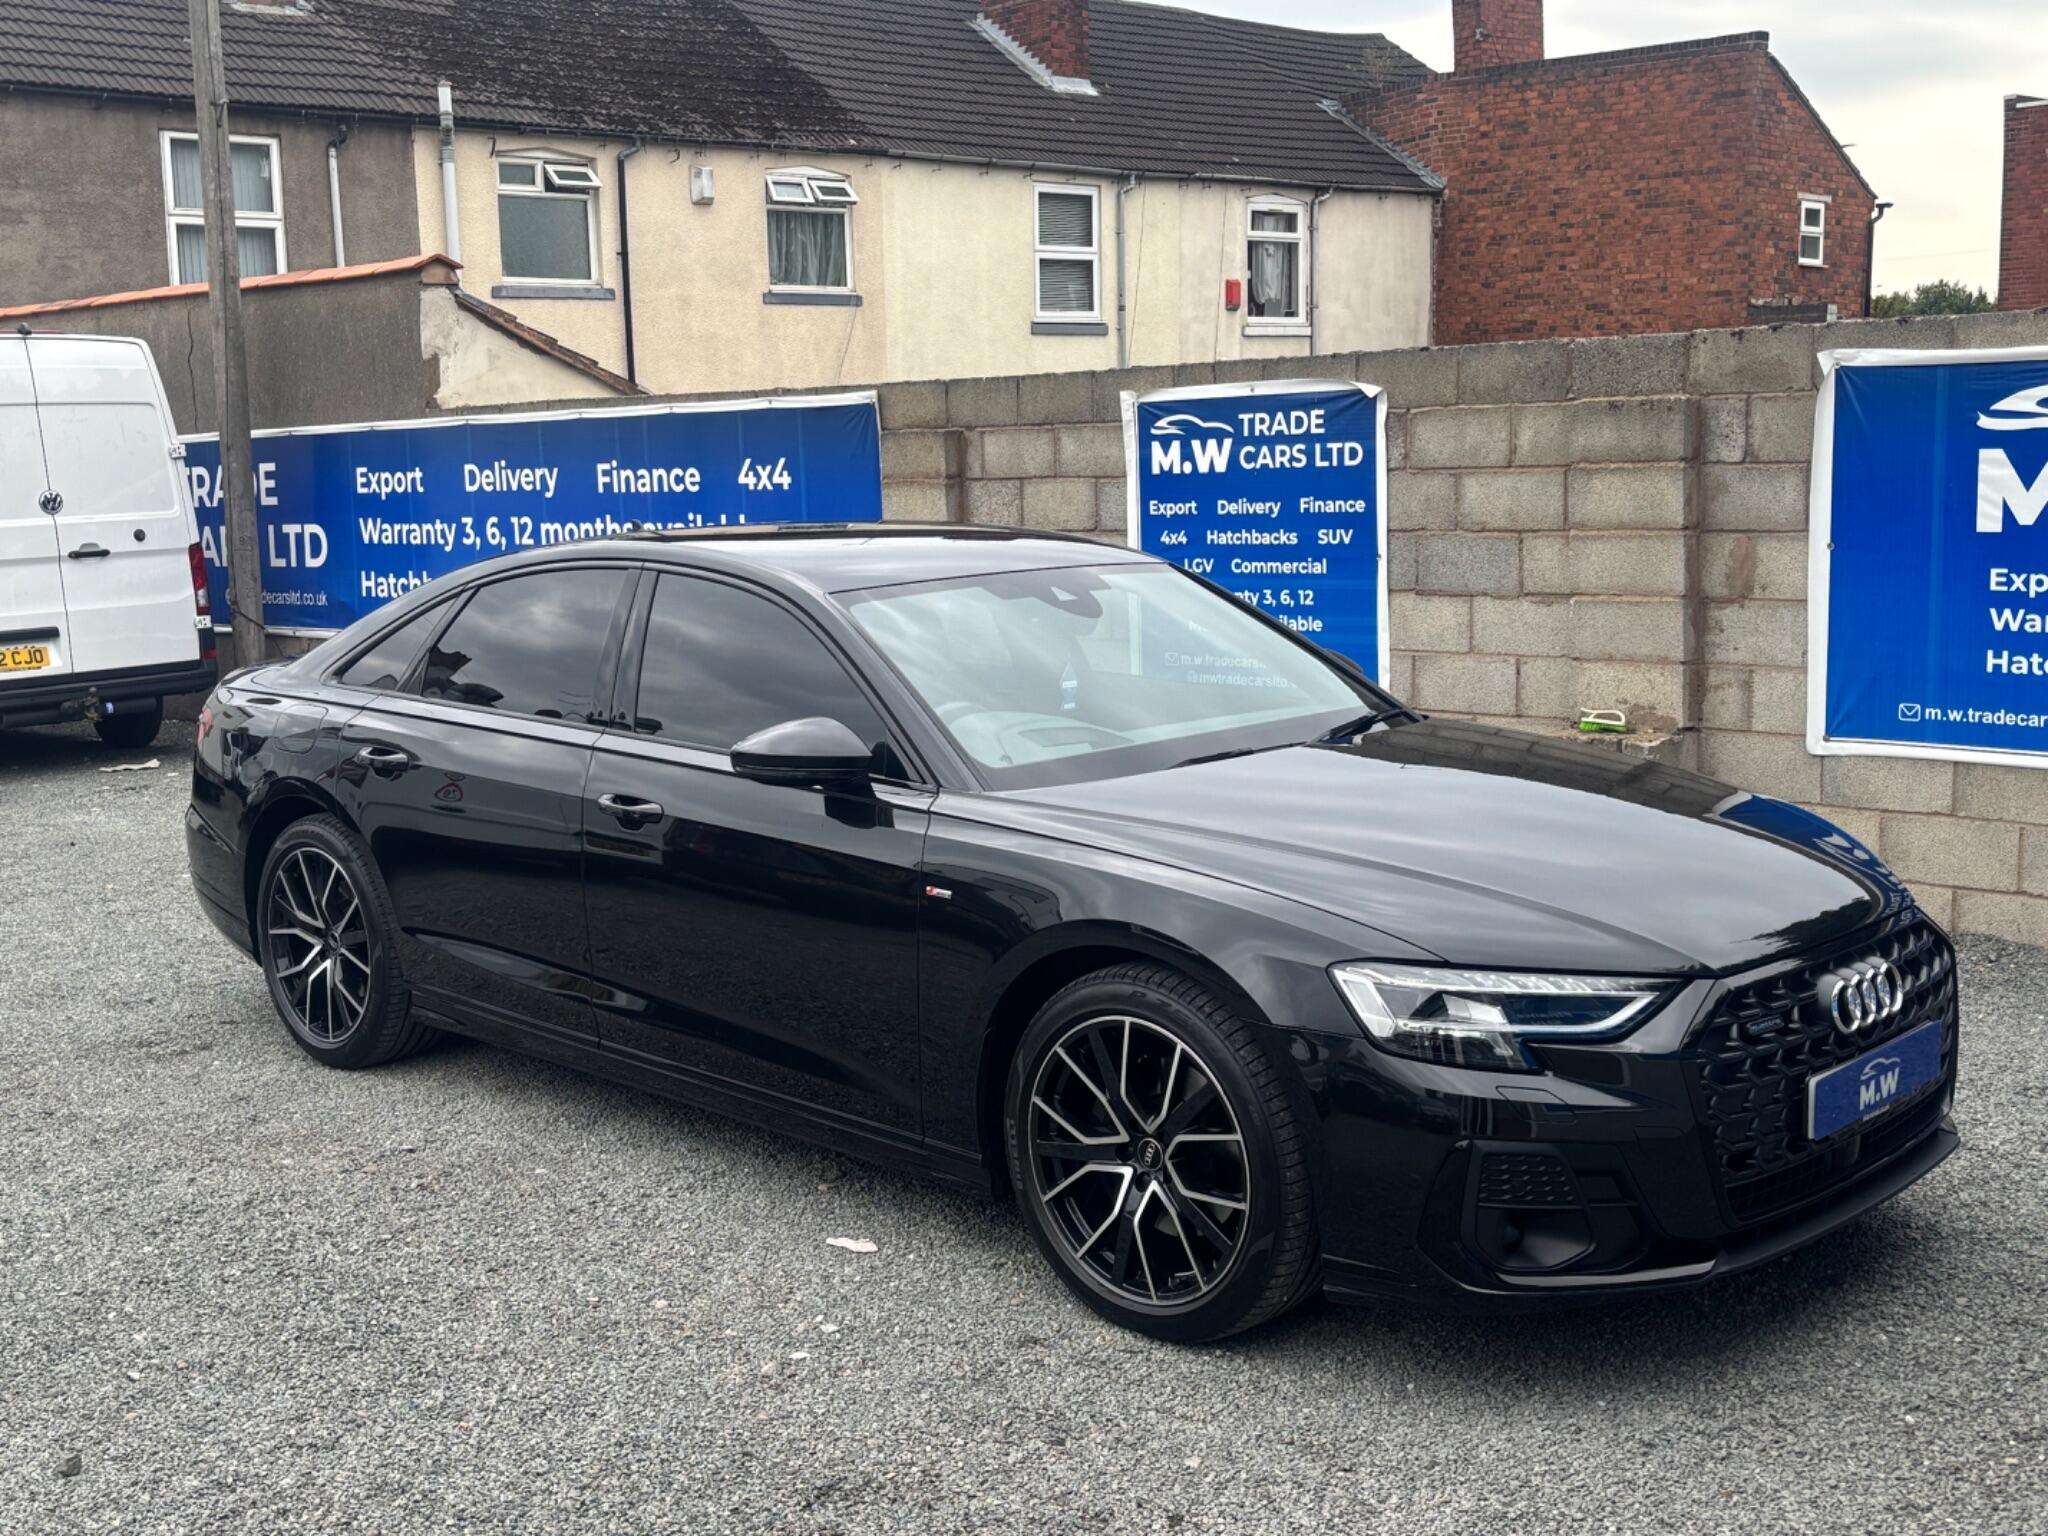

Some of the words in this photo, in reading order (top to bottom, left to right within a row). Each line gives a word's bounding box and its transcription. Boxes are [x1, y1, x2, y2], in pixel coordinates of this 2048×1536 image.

[1238, 409, 1326, 437] TRADE
[1150, 438, 1233, 475] M.W
[1238, 444, 1308, 470] CARS
[1314, 442, 1364, 468] LTD
[356, 467, 424, 500] Export
[463, 460, 558, 498] Delivery
[596, 460, 700, 494] Finance
[738, 457, 792, 491] 4x4
[1149, 500, 1198, 518] Export
[1216, 498, 1281, 518] Delivery
[1299, 496, 1366, 513] Finance
[267, 523, 328, 568] LTD
[359, 517, 456, 552] Warranty
[461, 516, 480, 550] 3,
[485, 516, 507, 550] 6,
[510, 516, 534, 545] 12
[1160, 530, 1188, 545] 4x4
[1206, 528, 1299, 545] Hatchbacks
[1317, 529, 1353, 545] SUV
[1184, 558, 1214, 573] LGV
[1231, 558, 1328, 575] Commercial
[1262, 590, 1276, 607] 3,
[1280, 590, 1294, 607] 6,
[1298, 590, 1314, 606] 12
[1859, 1067, 1900, 1111] M.W
